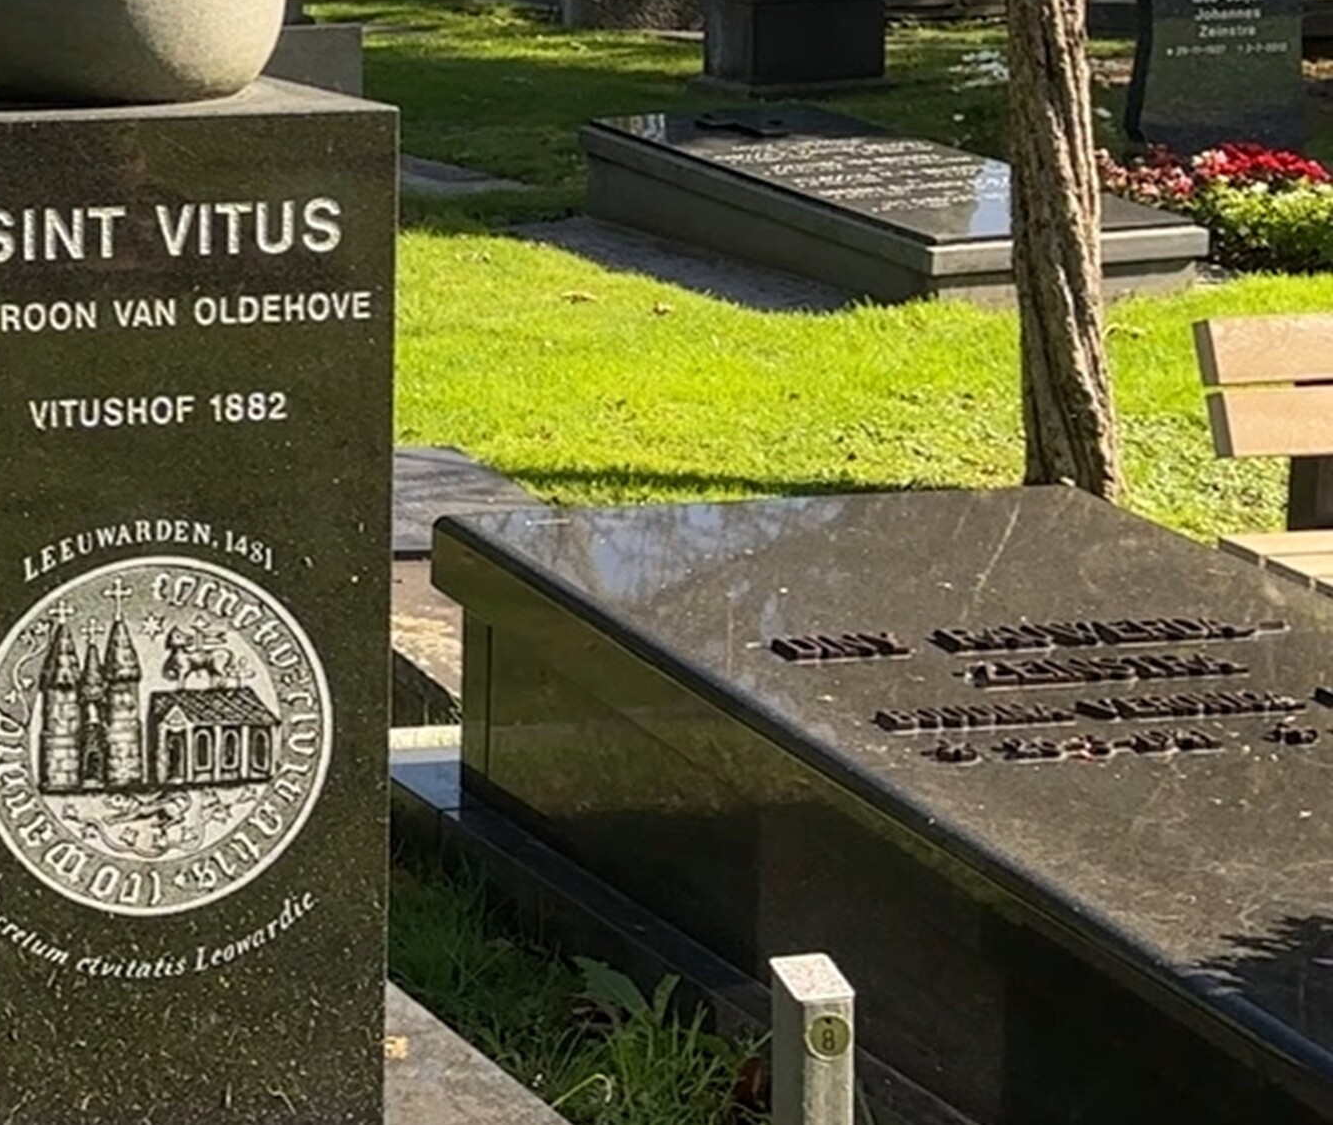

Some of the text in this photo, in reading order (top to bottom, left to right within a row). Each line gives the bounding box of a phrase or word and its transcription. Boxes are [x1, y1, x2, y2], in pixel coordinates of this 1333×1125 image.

[1194, 8, 1262, 21] Johannes
[1198, 25, 1257, 39] Zeinstra
[156, 197, 343, 257] VITUS
[113, 298, 177, 327] VAN
[193, 291, 373, 326] OLDEHOVE
[29, 391, 288, 430] VITUSHOF 1882
[770, 632, 916, 665] DINY
[952, 653, 1250, 692] ZEINSTRA
[1074, 688, 1308, 723] VERONICA
[76, 955, 187, 978] civitatis
[822, 1028, 835, 1051] 8
